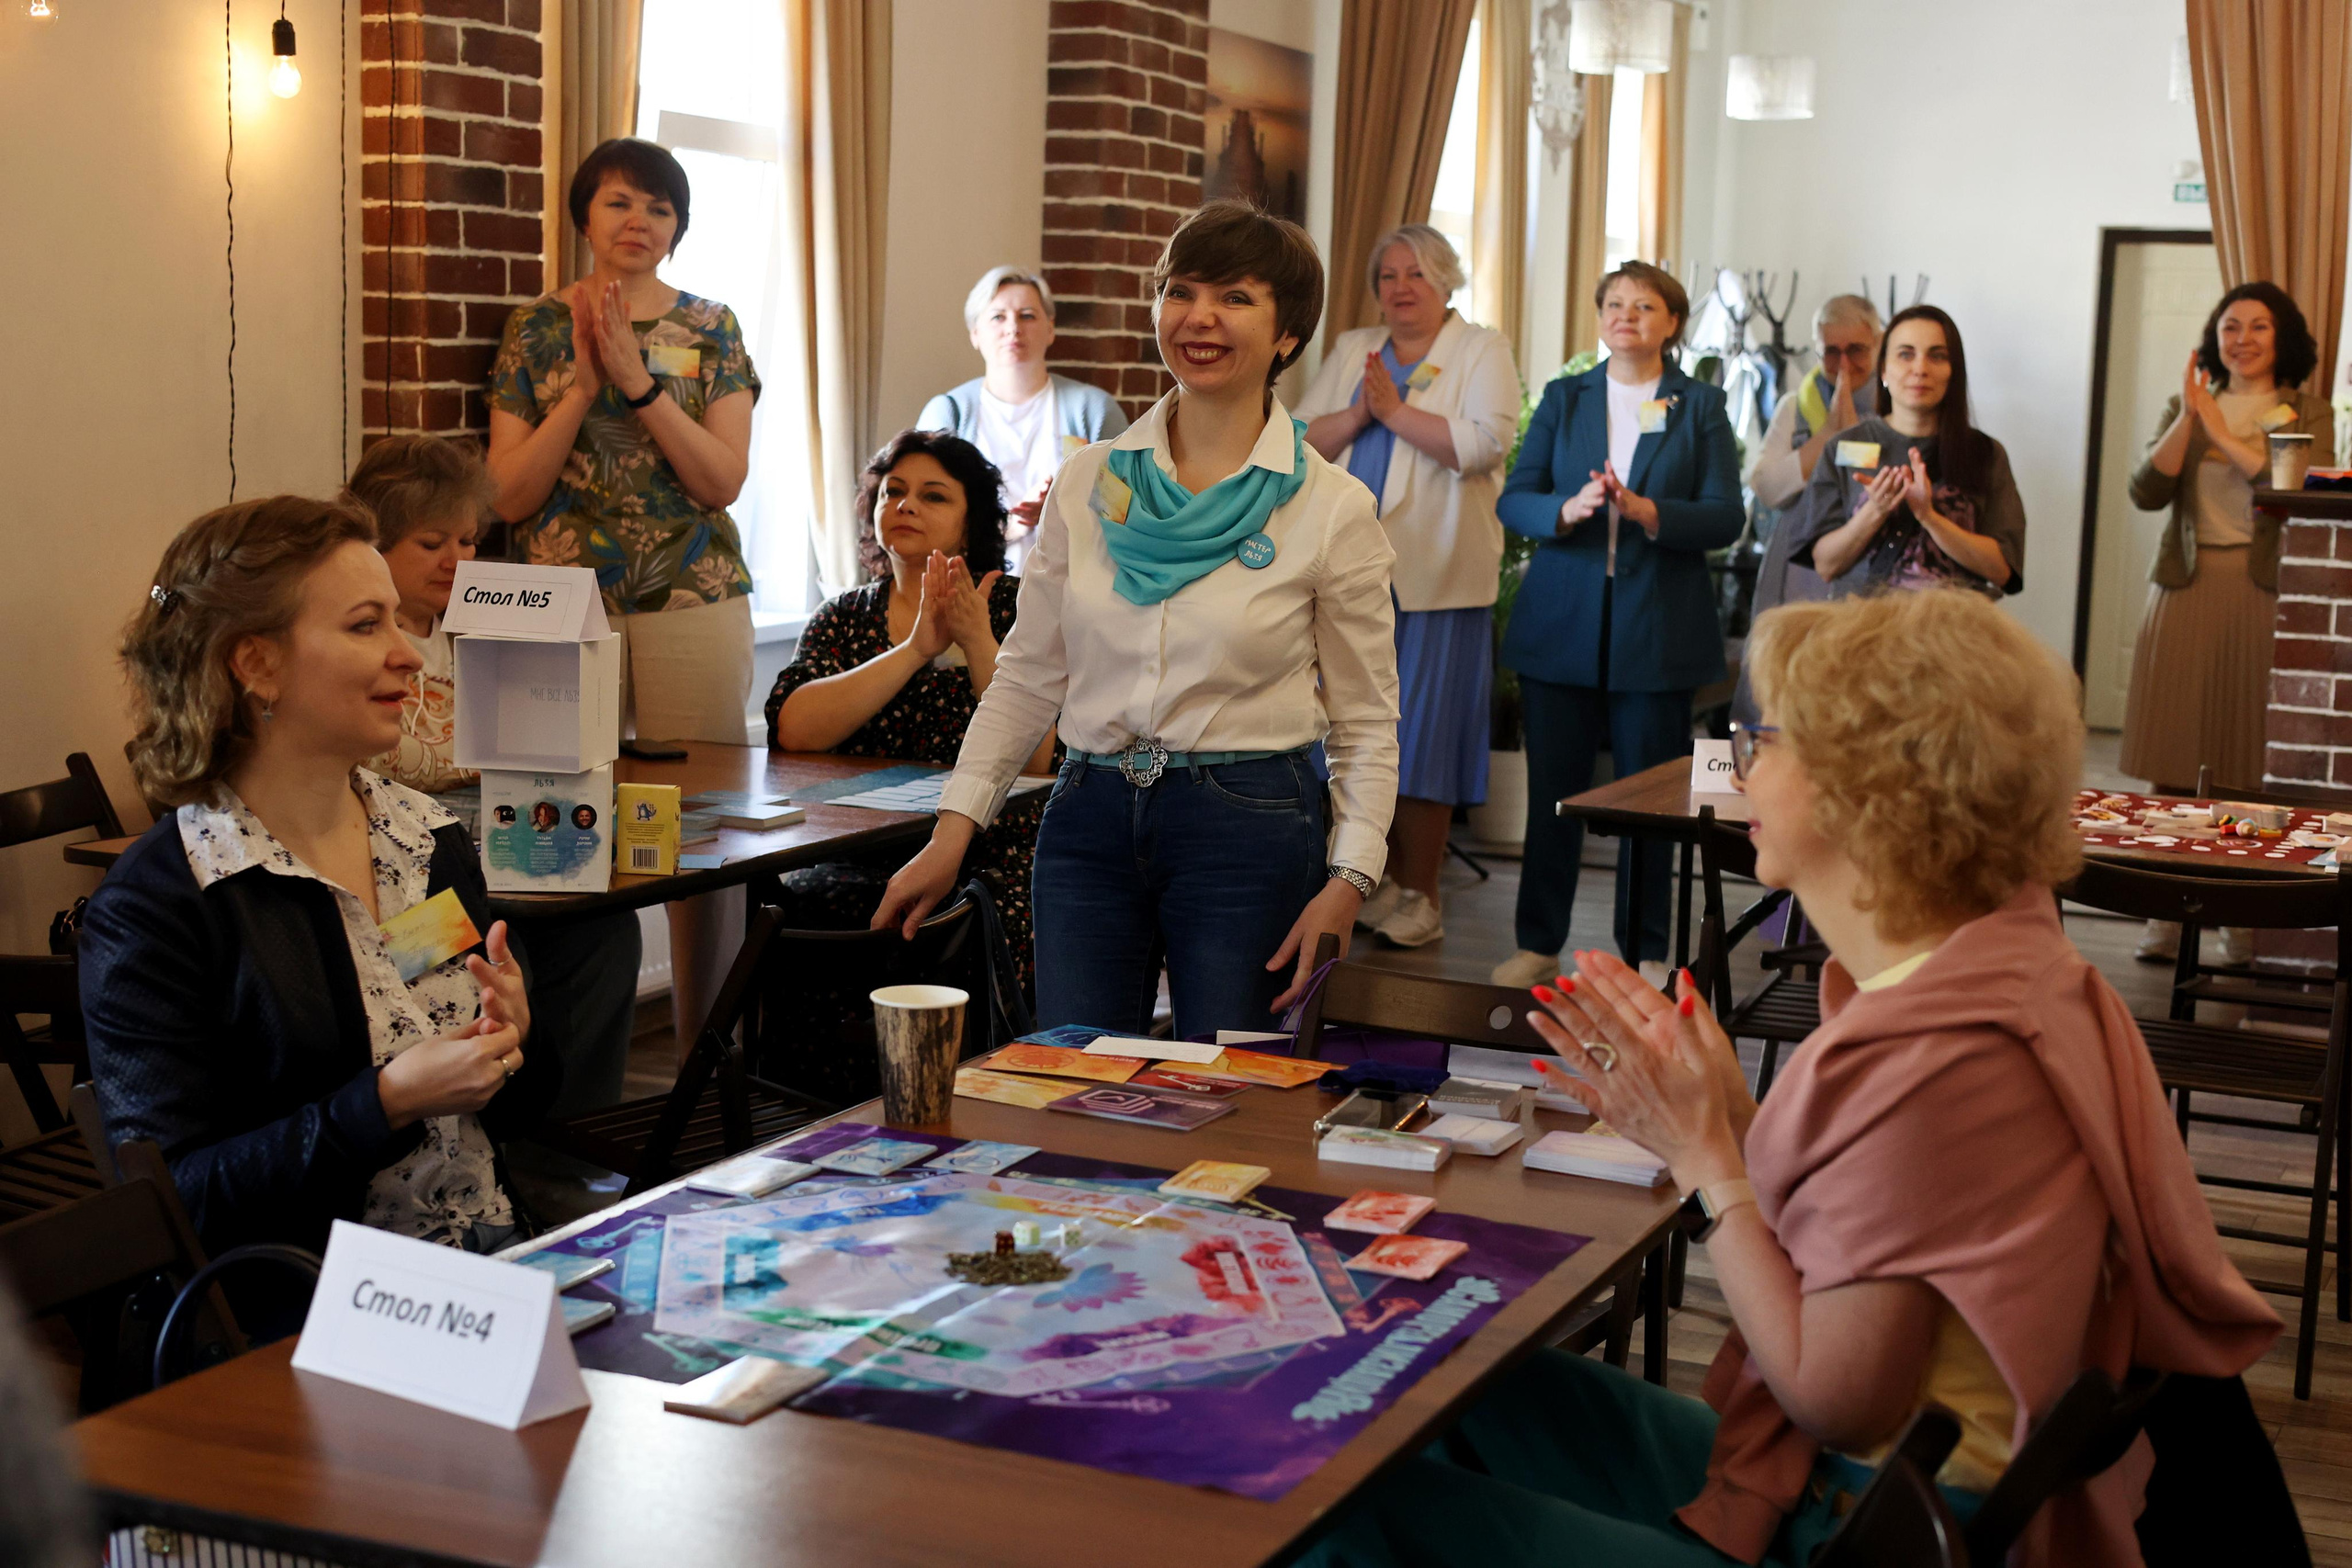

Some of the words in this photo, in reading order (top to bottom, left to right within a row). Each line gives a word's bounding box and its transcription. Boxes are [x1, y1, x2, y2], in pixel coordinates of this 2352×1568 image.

[1245, 539, 1272, 553] МАСТЕР
[1244, 550, 1263, 561] ЛЬЗЯ
[464, 586, 514, 605] Стол
[516, 590, 551, 608] №5
[353, 1280, 433, 1325] Стол
[437, 1300, 495, 1342] №4
